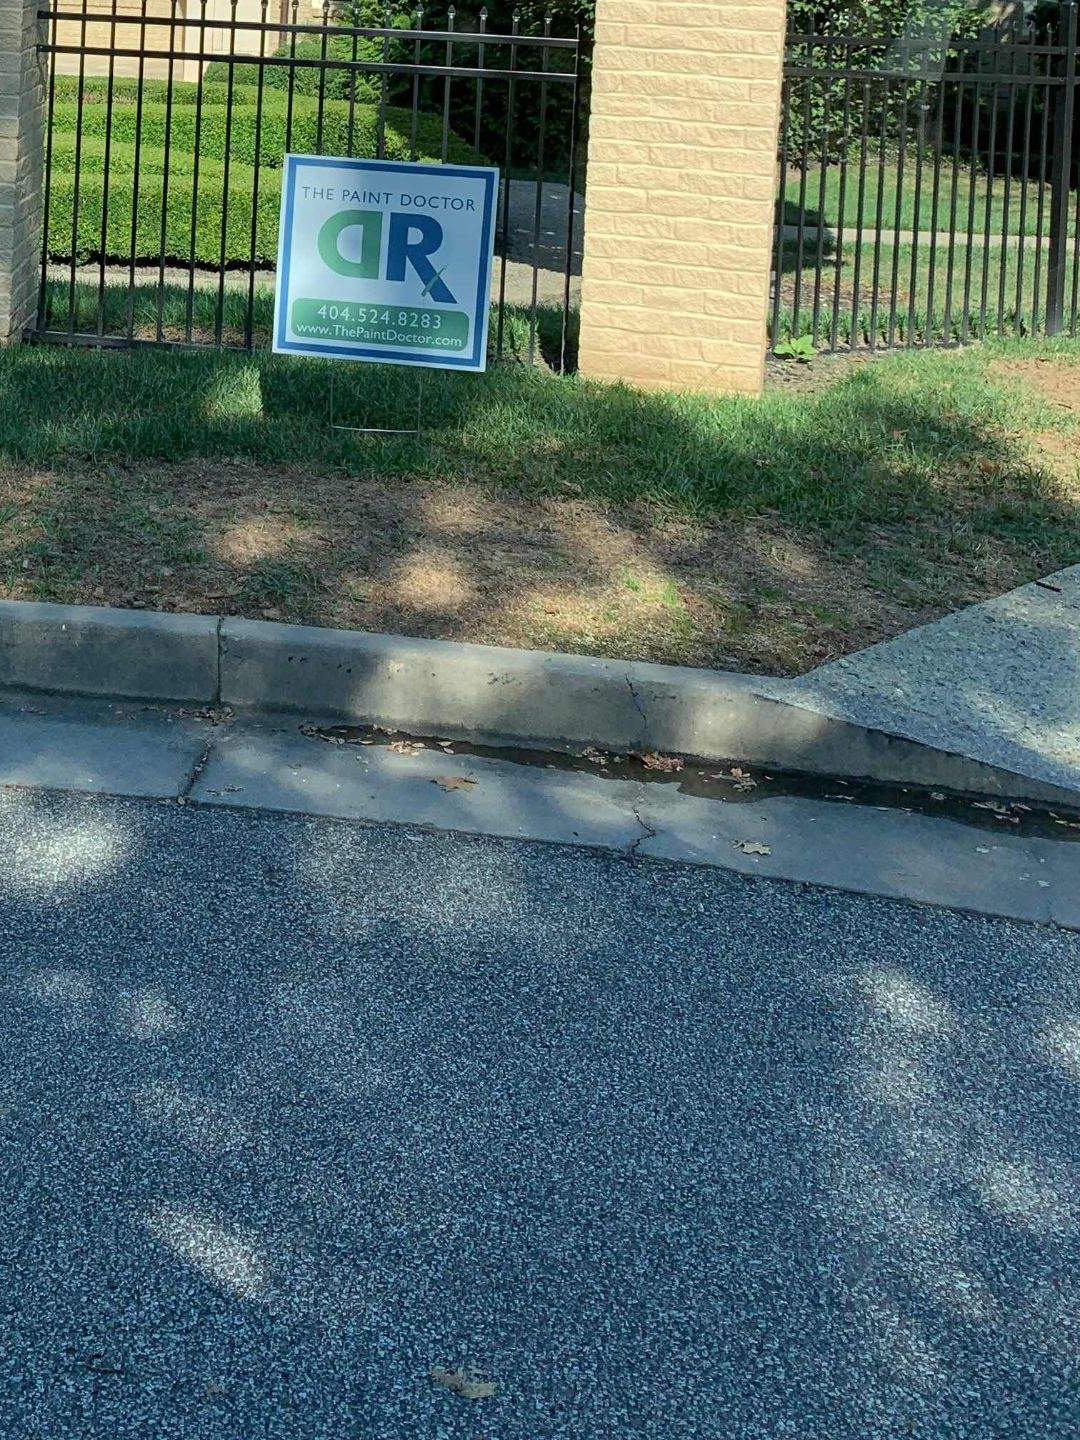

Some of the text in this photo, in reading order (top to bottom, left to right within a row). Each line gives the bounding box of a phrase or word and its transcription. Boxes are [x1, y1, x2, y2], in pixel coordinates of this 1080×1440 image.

[302, 186, 476, 212] THE PAINT DOCTOR
[317, 305, 442, 330] 404.524.8283
[296, 323, 462, 348] www.ThePaintDoctor.com
